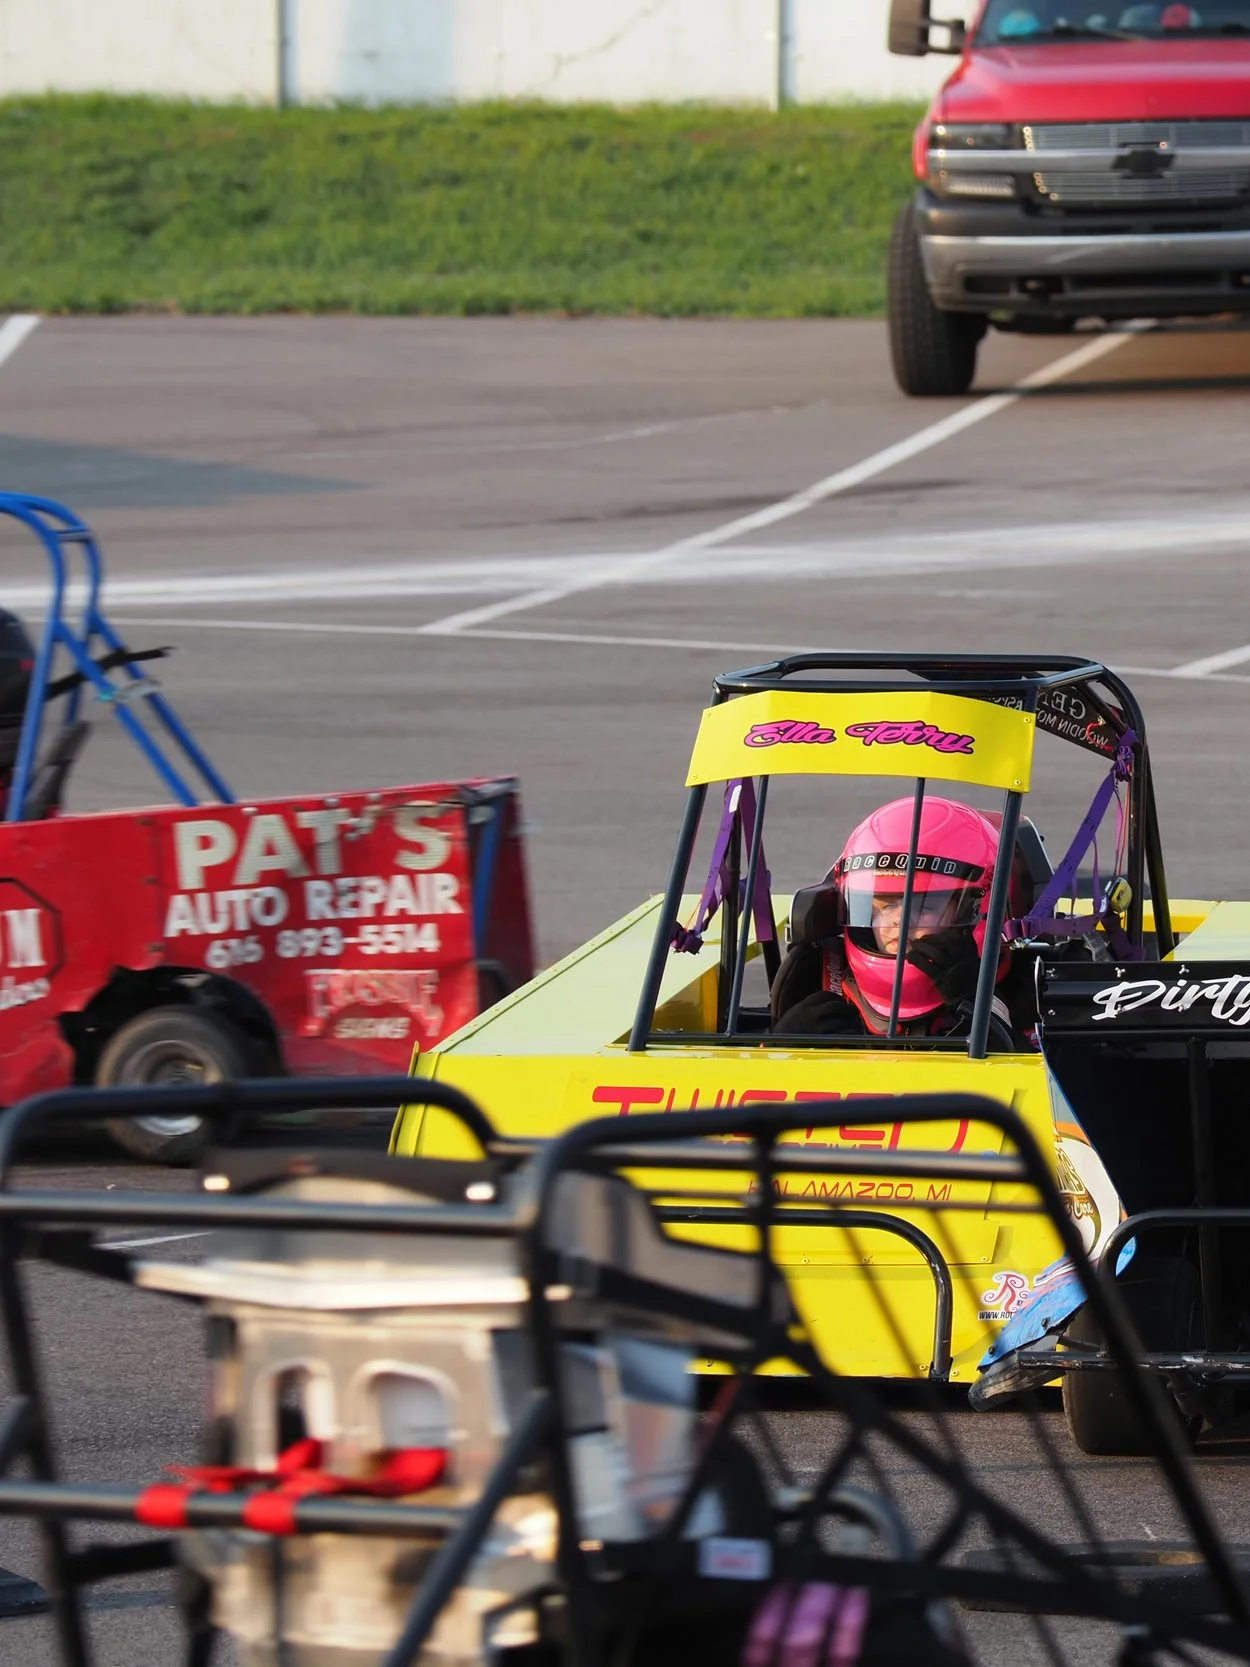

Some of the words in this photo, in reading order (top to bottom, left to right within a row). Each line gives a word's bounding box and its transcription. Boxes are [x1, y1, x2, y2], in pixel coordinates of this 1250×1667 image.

[743, 719, 838, 749] Ella
[844, 721, 976, 755] Terry
[172, 803, 454, 891] PAT'S
[163, 885, 290, 939] AUTO
[303, 871, 465, 921] REPAIR
[275, 922, 441, 959] 893-5514
[925, 1184, 954, 1202] MI
